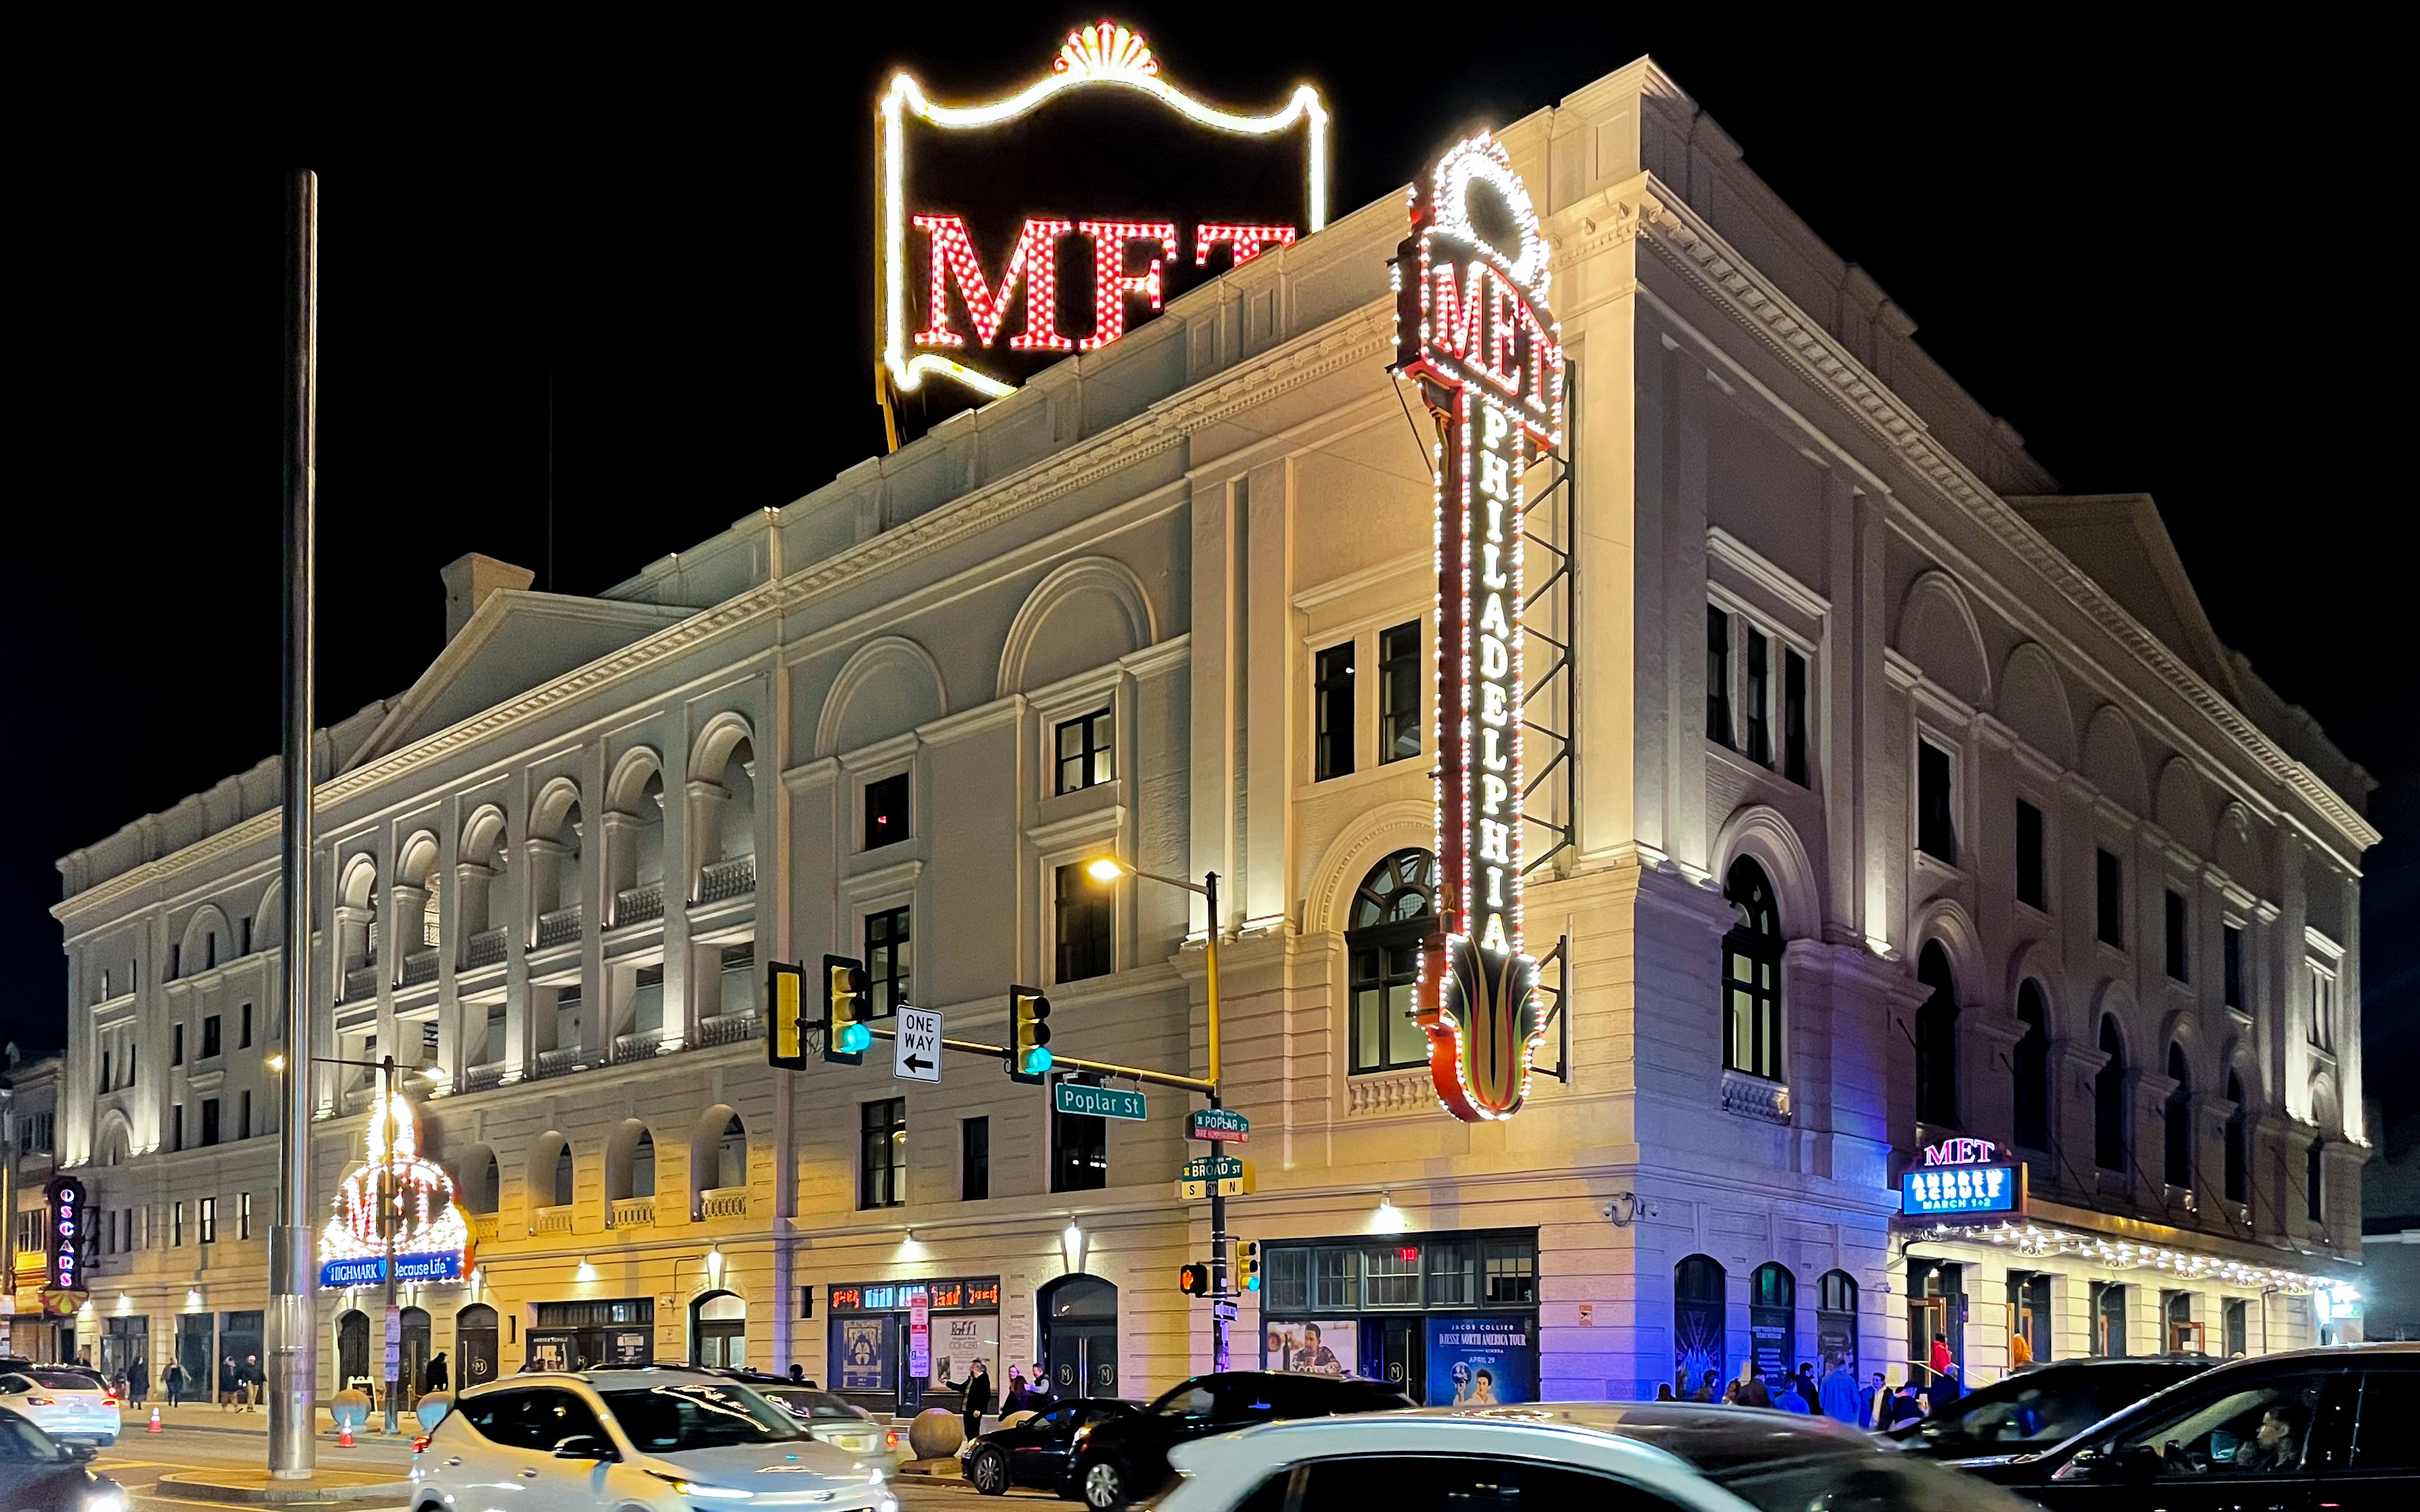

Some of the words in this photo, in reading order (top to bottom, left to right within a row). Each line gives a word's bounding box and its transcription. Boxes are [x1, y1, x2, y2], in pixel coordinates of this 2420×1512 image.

[1432, 260, 1553, 413] MET
[1479, 404, 1510, 956] PHILADELPHIA
[906, 1014, 934, 1033] ONE
[904, 1033, 934, 1051] WAY
[1065, 1090, 1116, 1114] Poplar
[1124, 1097, 1139, 1114] St
[1205, 1116, 1238, 1130] POPLAR
[1240, 1123, 1247, 1132] ST
[1924, 1138, 1995, 1166] MET
[1192, 1163, 1228, 1177] BROAD
[1232, 1165, 1241, 1174] ST
[1912, 1169, 2003, 1189] ANDREW
[1190, 1184, 1195, 1195] S
[1229, 1181, 1235, 1192] N
[1922, 1199, 1967, 1210] MARCH
[59, 1189, 75, 1287] OSCARS
[330, 1264, 378, 1282] HIGHMARK
[1508, 1334, 1526, 1346] TOUR
